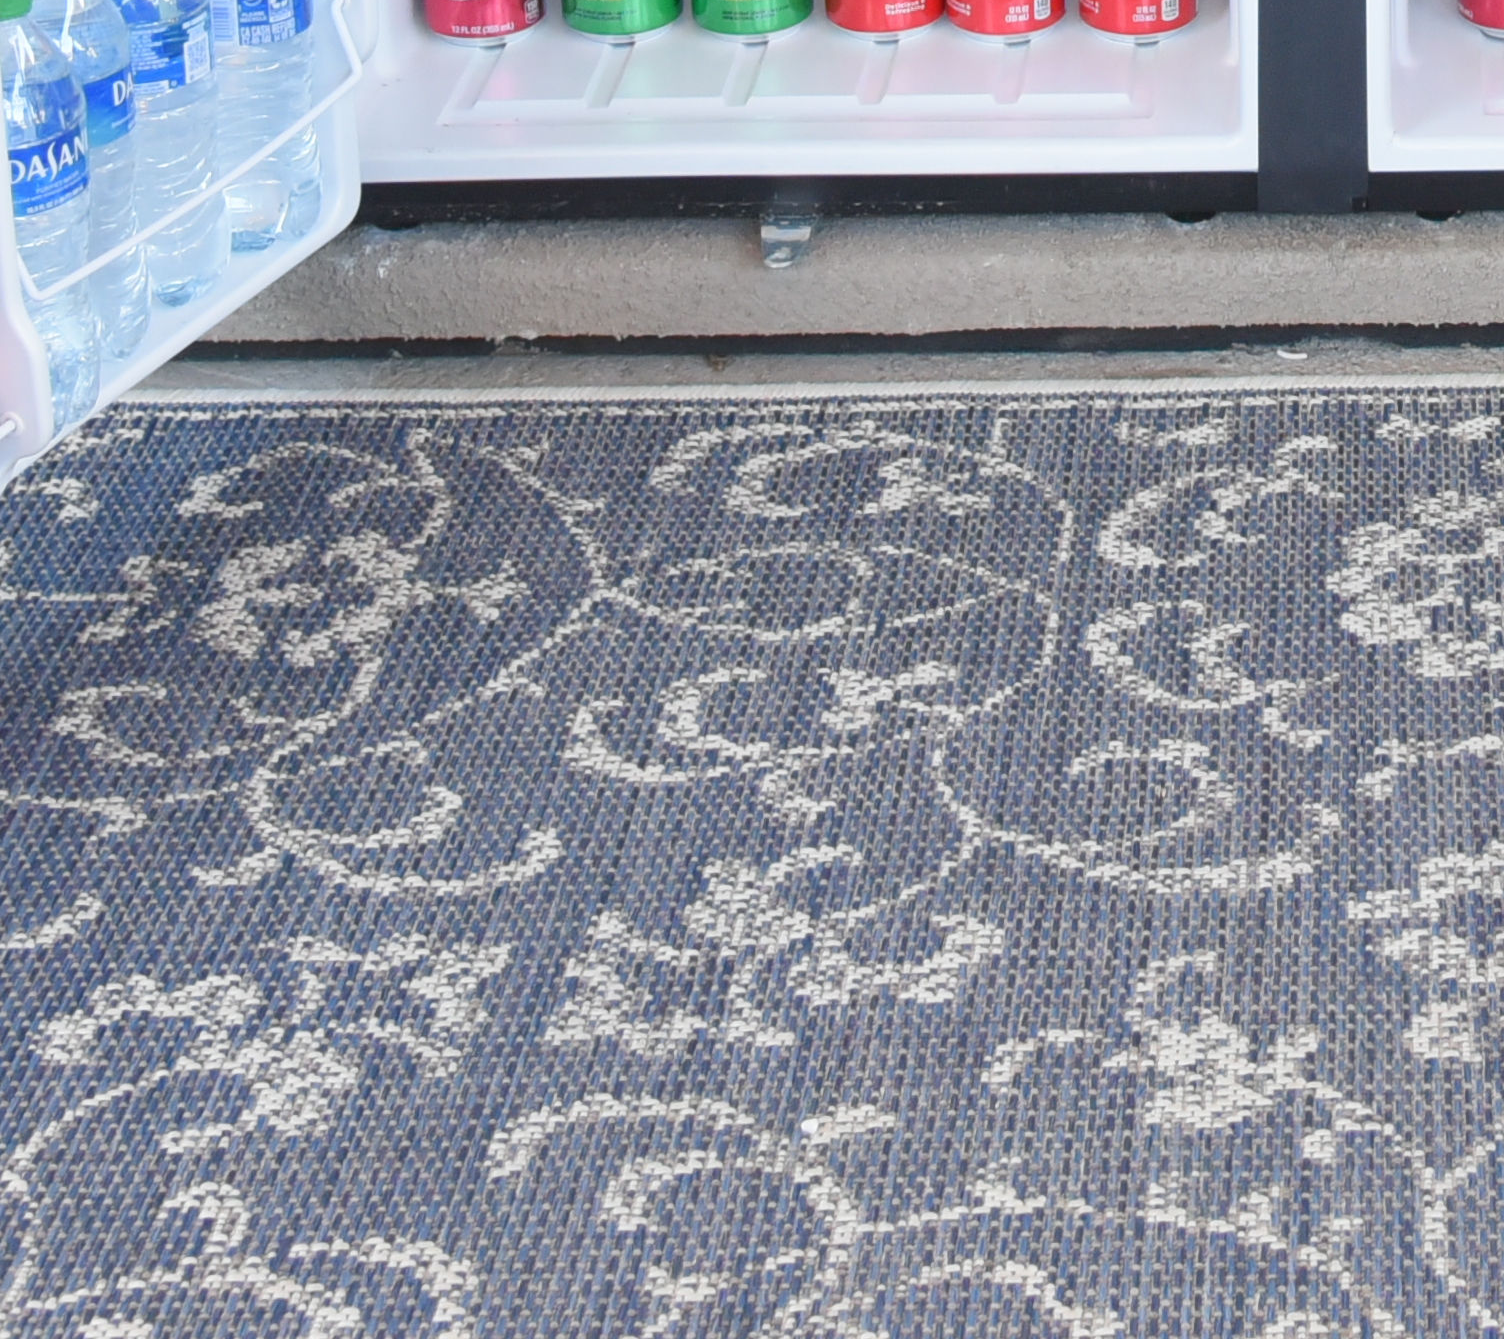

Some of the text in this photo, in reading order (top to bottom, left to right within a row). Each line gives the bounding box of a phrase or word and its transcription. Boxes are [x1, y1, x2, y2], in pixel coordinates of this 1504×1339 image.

[461, 25, 482, 35] FL OZ
[9, 135, 87, 185] DASAN
